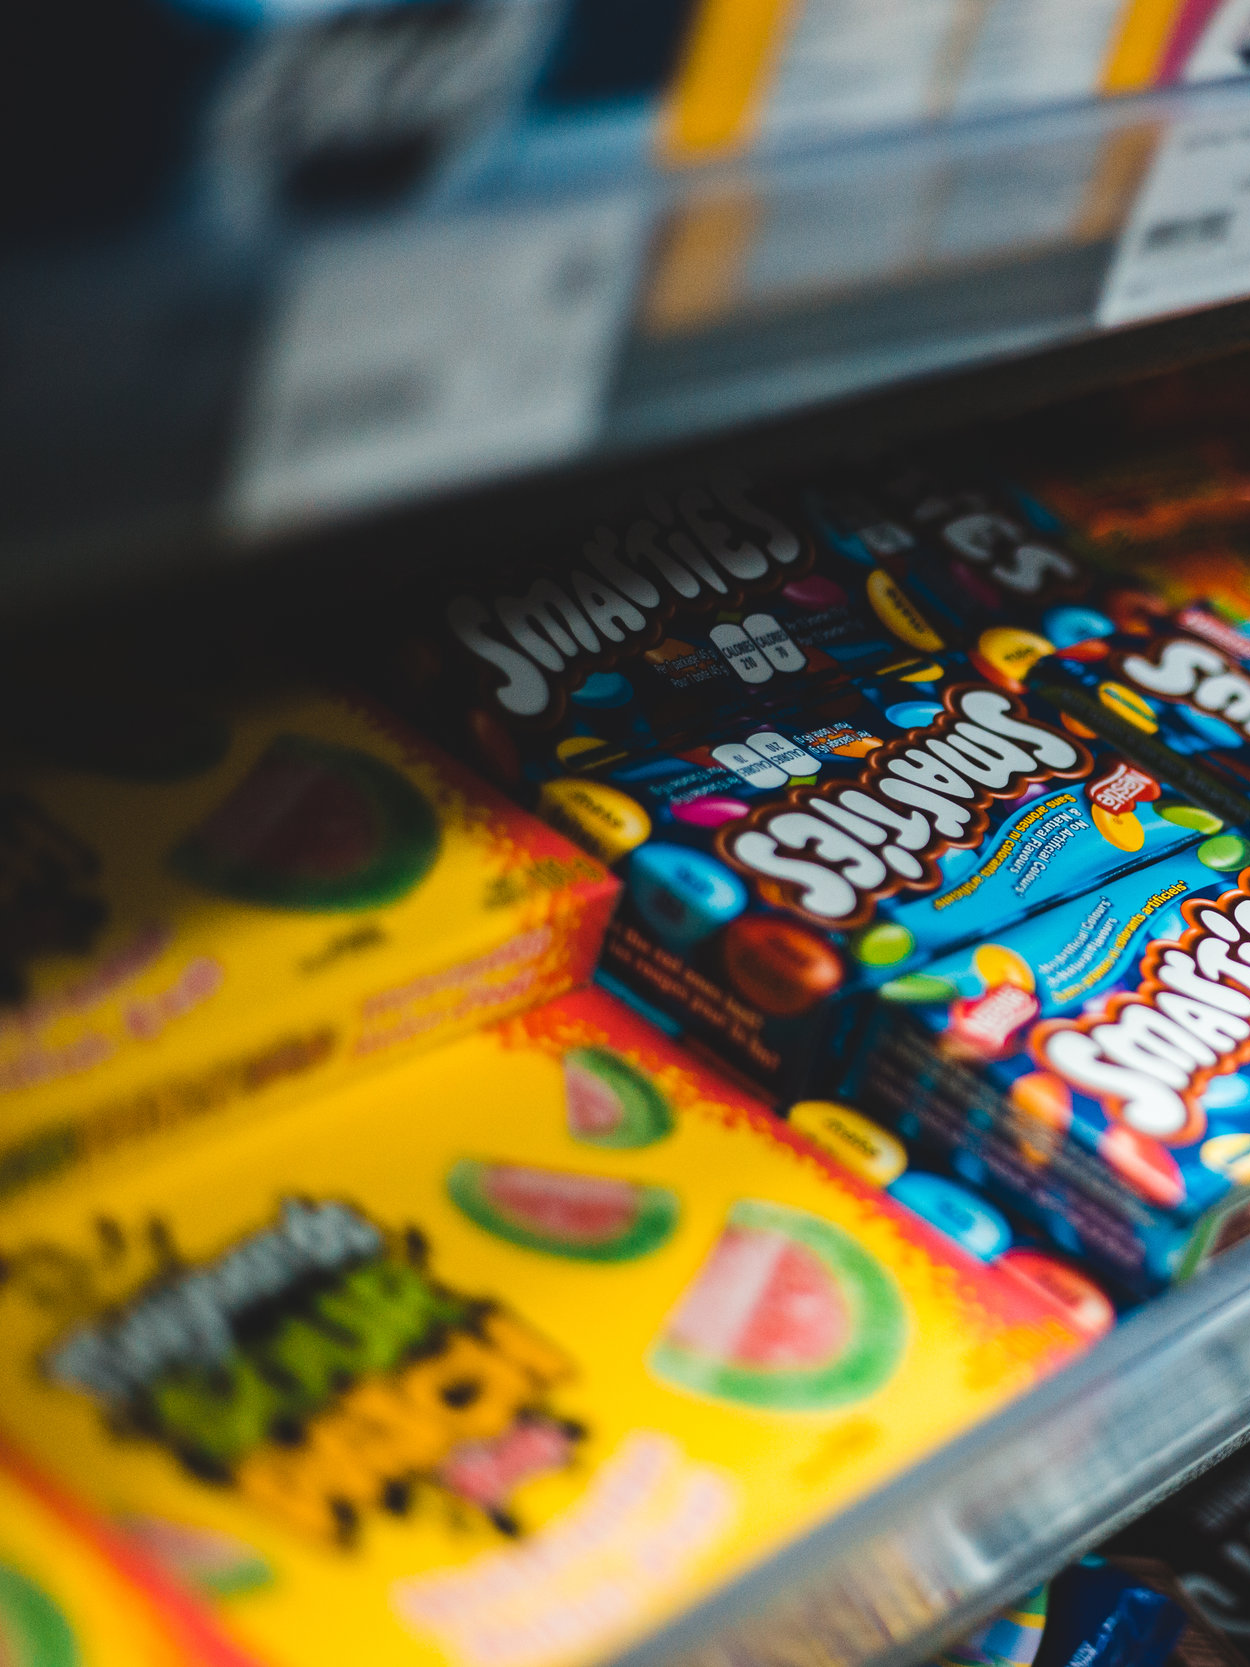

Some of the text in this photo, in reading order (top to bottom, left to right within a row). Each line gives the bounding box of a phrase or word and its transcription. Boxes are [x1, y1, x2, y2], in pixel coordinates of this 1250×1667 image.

[739, 656, 759, 671] 210
[764, 741, 785, 752] 210
[769, 748, 807, 763] CALORIES
[736, 760, 773, 777] CALORIES
[1046, 793, 1077, 809] Sans
[1015, 805, 1049, 832] arômes
[1069, 818, 1090, 831] No
[1008, 831, 1022, 843] ni
[1009, 807, 1083, 875] & Natural Flavours
[1038, 829, 1076, 864] Artificial
[979, 839, 1016, 877] colorants
